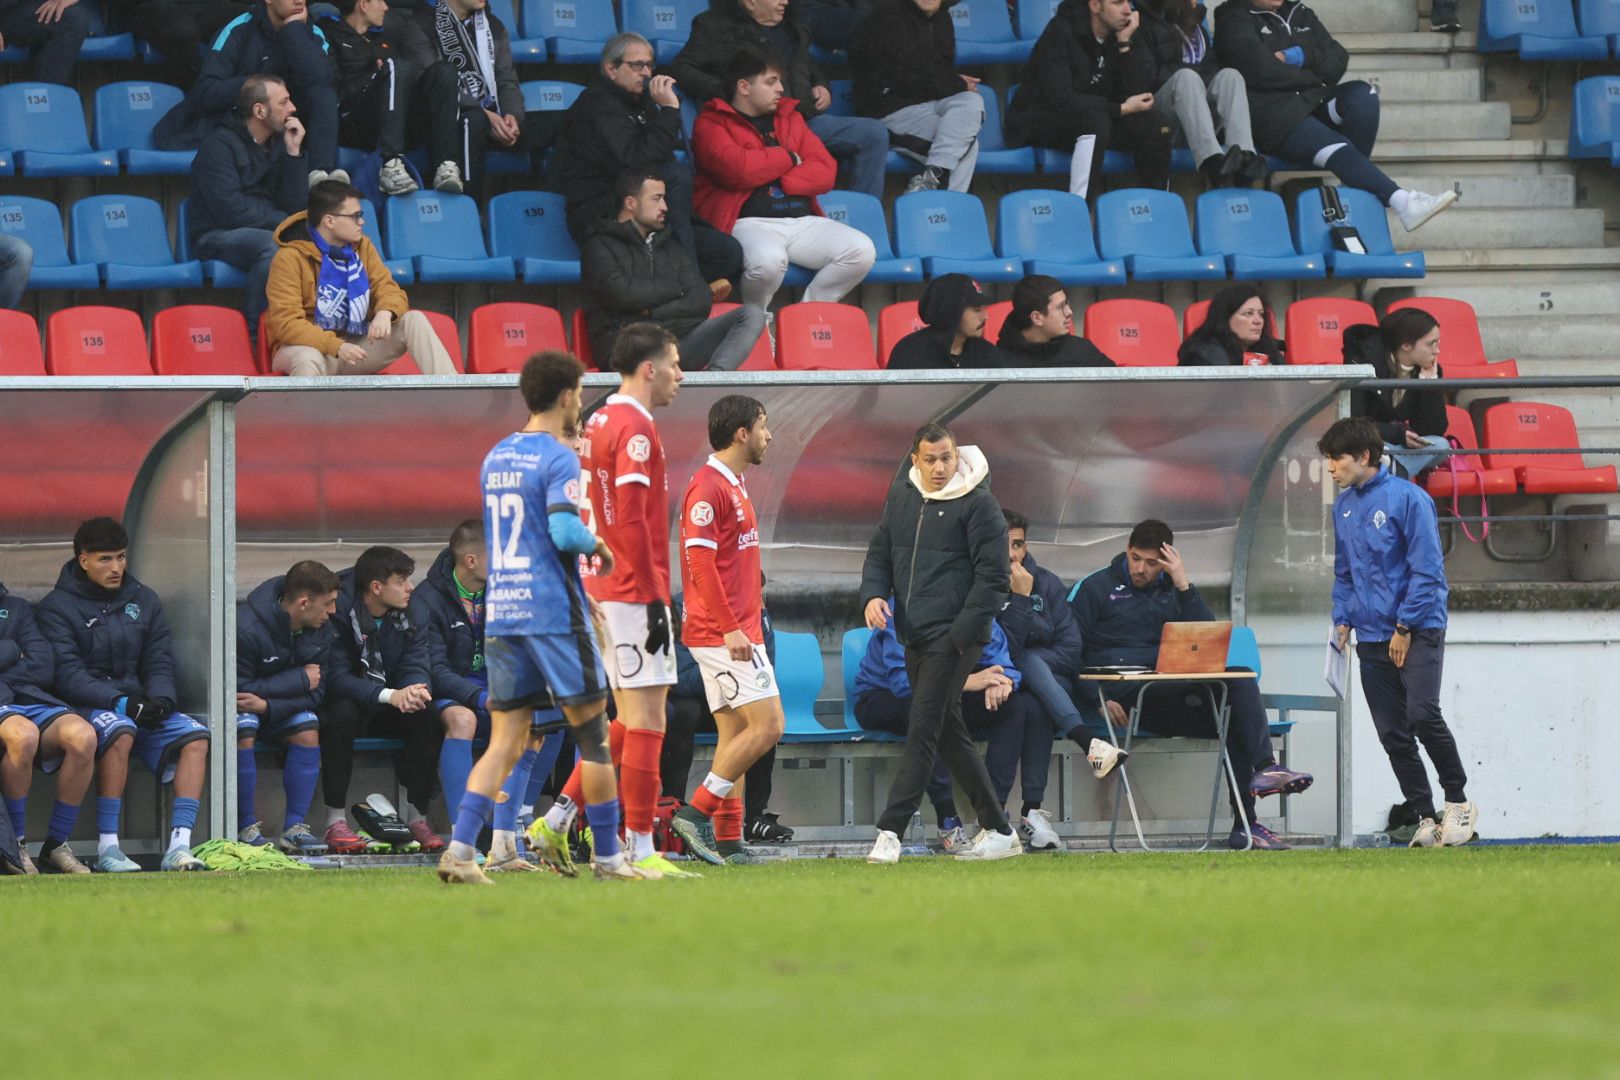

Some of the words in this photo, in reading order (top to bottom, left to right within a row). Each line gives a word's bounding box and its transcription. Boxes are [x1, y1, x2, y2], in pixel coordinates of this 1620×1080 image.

[555, 9, 575, 20] 128
[1518, 4, 1535, 15] 121
[656, 12, 674, 22] 127
[1607, 86, 1620, 96] 12
[27, 95, 48, 105] 134
[130, 92, 151, 102] 133
[543, 92, 562, 102] 129
[420, 204, 439, 215] 131
[525, 207, 545, 218] 130
[1032, 205, 1052, 216] 125
[1130, 205, 1151, 215] 124
[1230, 203, 1250, 214] 123
[2, 212, 23, 223] 135
[105, 210, 126, 221] 134
[928, 213, 947, 225] 126
[1539, 291, 1554, 312] 5
[1320, 320, 1339, 331] 123
[506, 329, 526, 339] 131
[812, 331, 832, 342] 128
[1120, 327, 1139, 338] 125
[83, 336, 103, 347] 135
[191, 334, 211, 344] 134
[1518, 414, 1537, 425] 122
[486, 492, 531, 571] 12
[487, 587, 534, 601] ABANCA
[92, 710, 119, 729] 19
